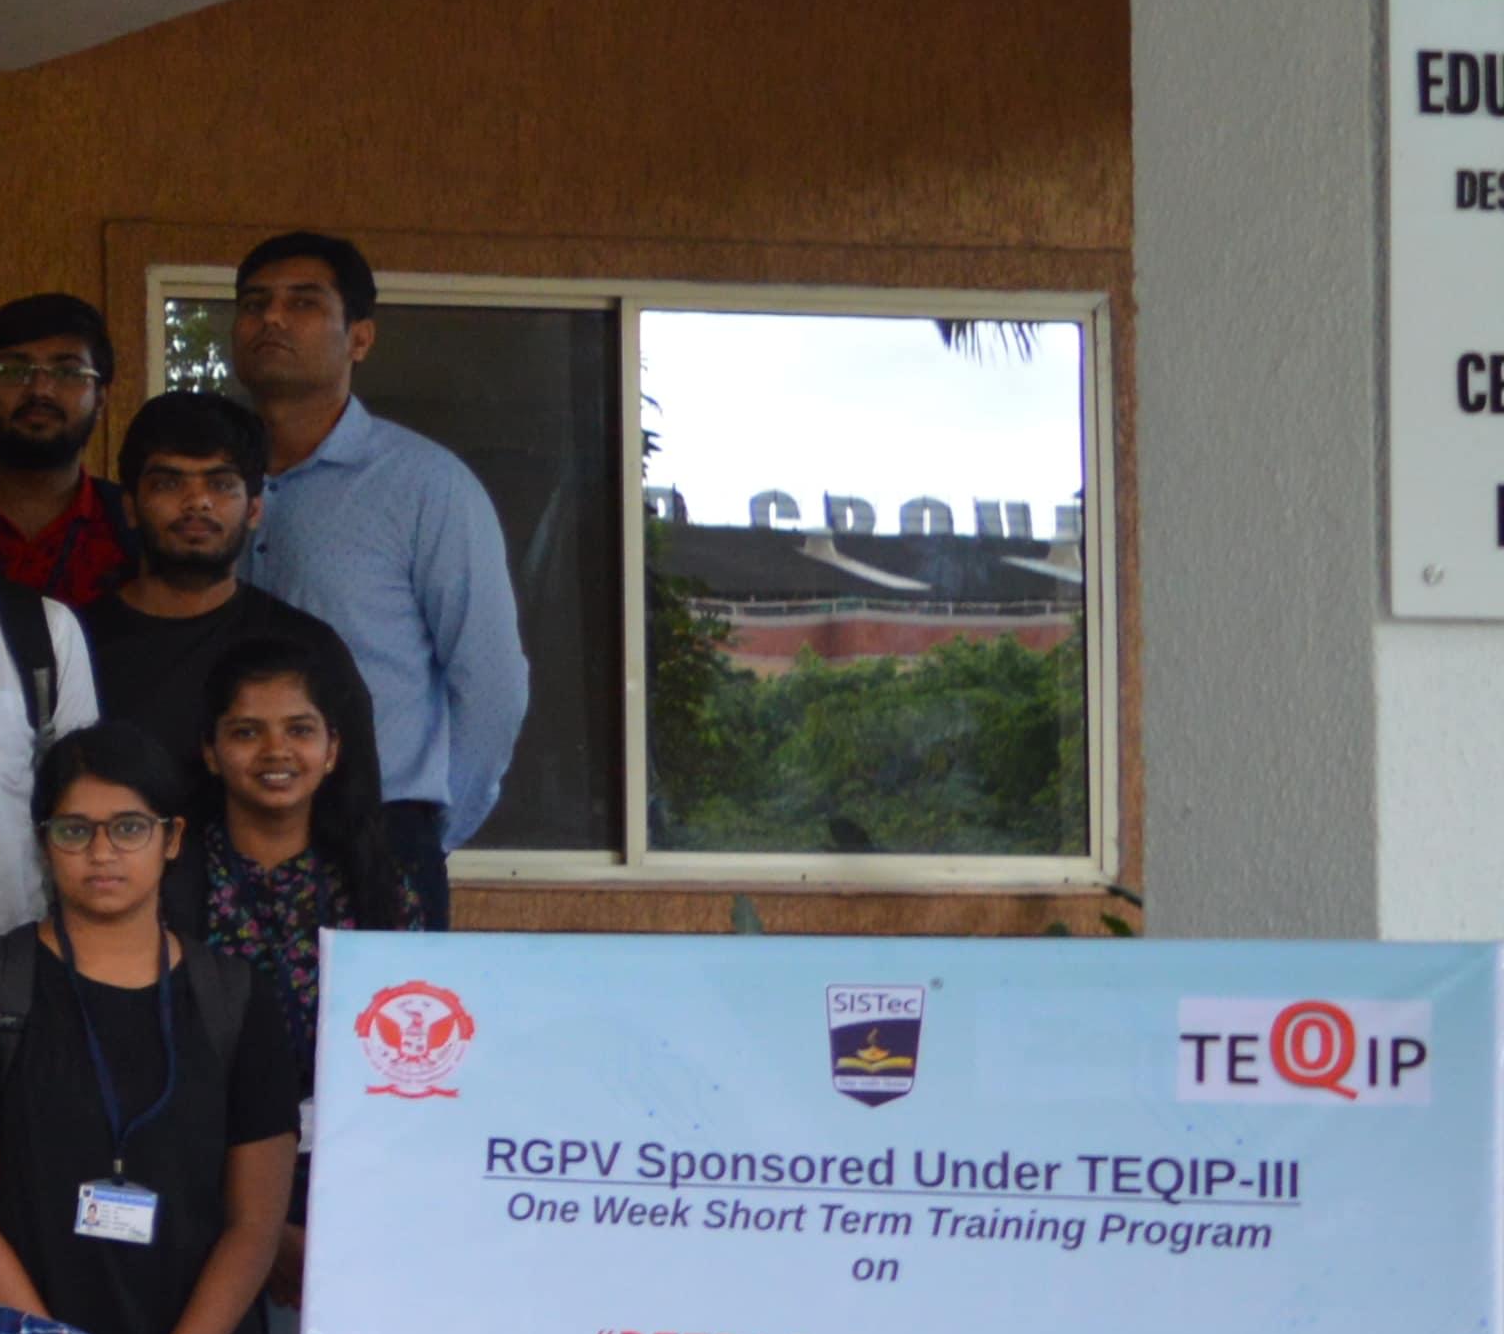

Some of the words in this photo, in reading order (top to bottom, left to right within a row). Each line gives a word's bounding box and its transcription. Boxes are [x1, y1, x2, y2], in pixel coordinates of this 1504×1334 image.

[832, 990, 919, 1016] SISTec
[1179, 998, 1428, 1100] TEQIP
[486, 1137, 622, 1177] RGPV
[636, 1140, 895, 1190] Sponsored
[914, 1150, 1062, 1191] Under
[1077, 1154, 1300, 1204] TEQIP-III
[507, 1192, 580, 1224] One
[593, 1195, 692, 1228] Week
[703, 1199, 807, 1233] Short
[819, 1204, 913, 1236] Term
[928, 1207, 1086, 1250] Training
[1098, 1213, 1273, 1254] Program
[851, 1256, 900, 1283] on
